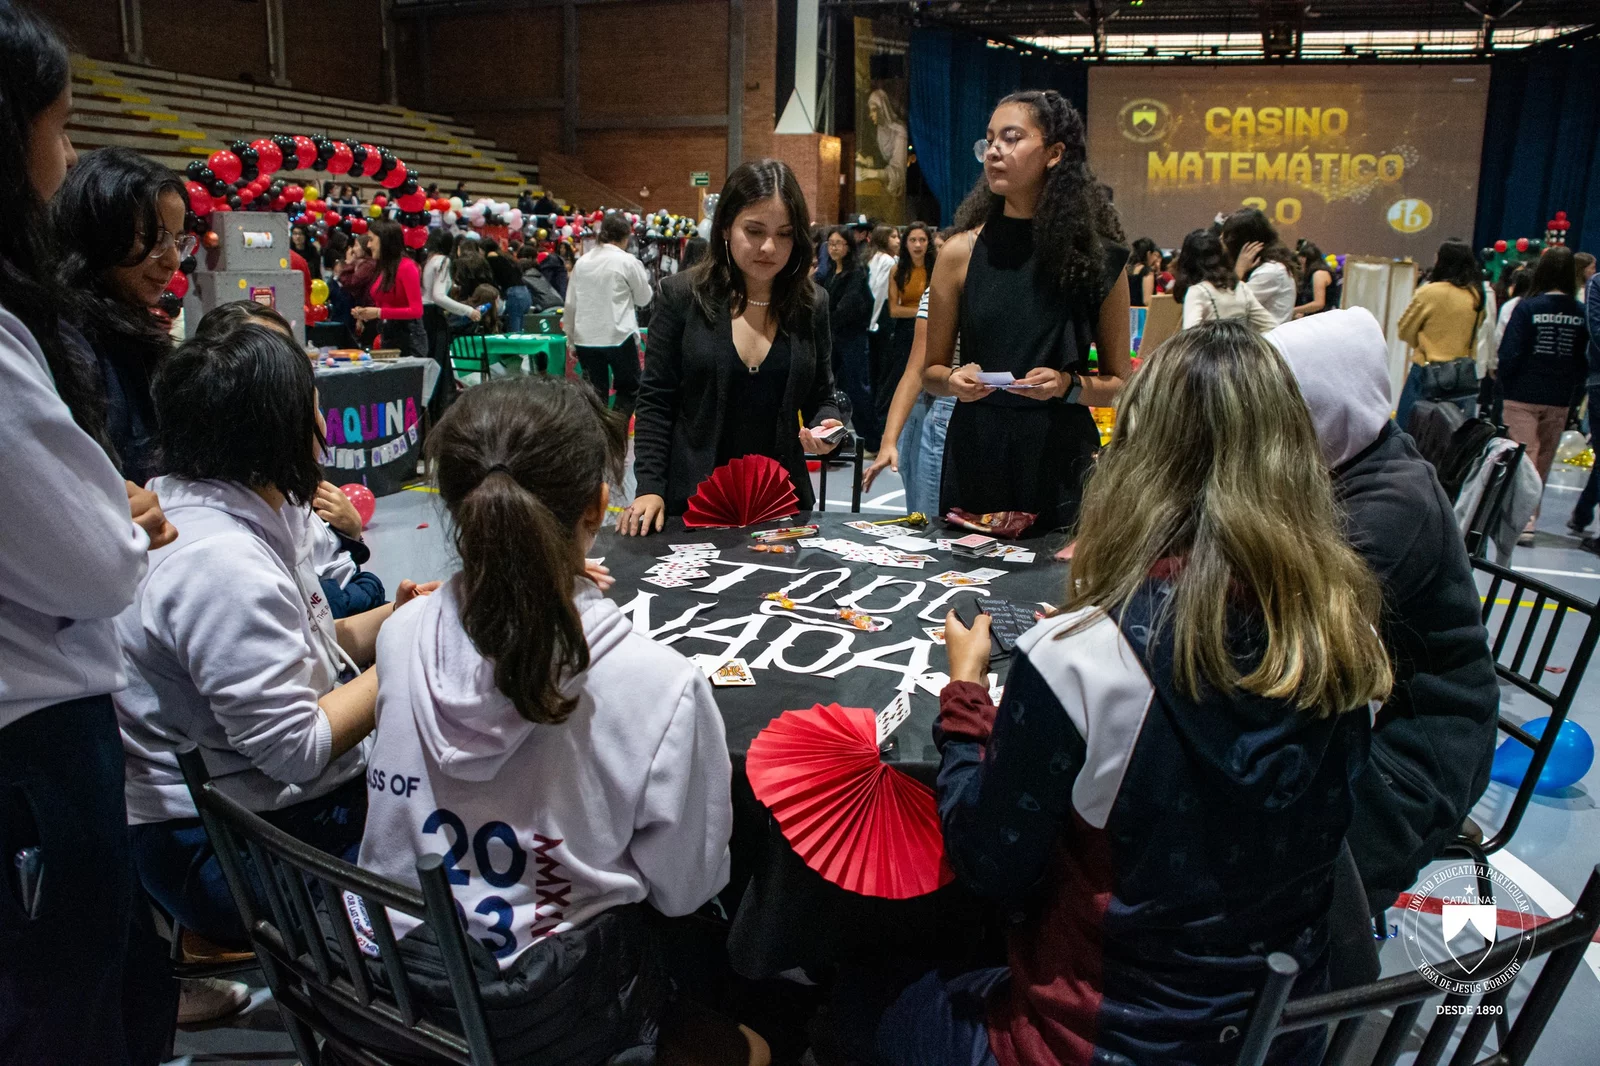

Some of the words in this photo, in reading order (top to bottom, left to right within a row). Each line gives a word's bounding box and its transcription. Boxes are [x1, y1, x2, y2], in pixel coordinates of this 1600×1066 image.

[1204, 106, 1350, 137] CASINO
[1147, 145, 1405, 182] MATEMÁTICO
[320, 396, 419, 447] AQUINA
[390, 773, 421, 798] OF
[422, 808, 528, 889] 20
[452, 895, 518, 960] 3
